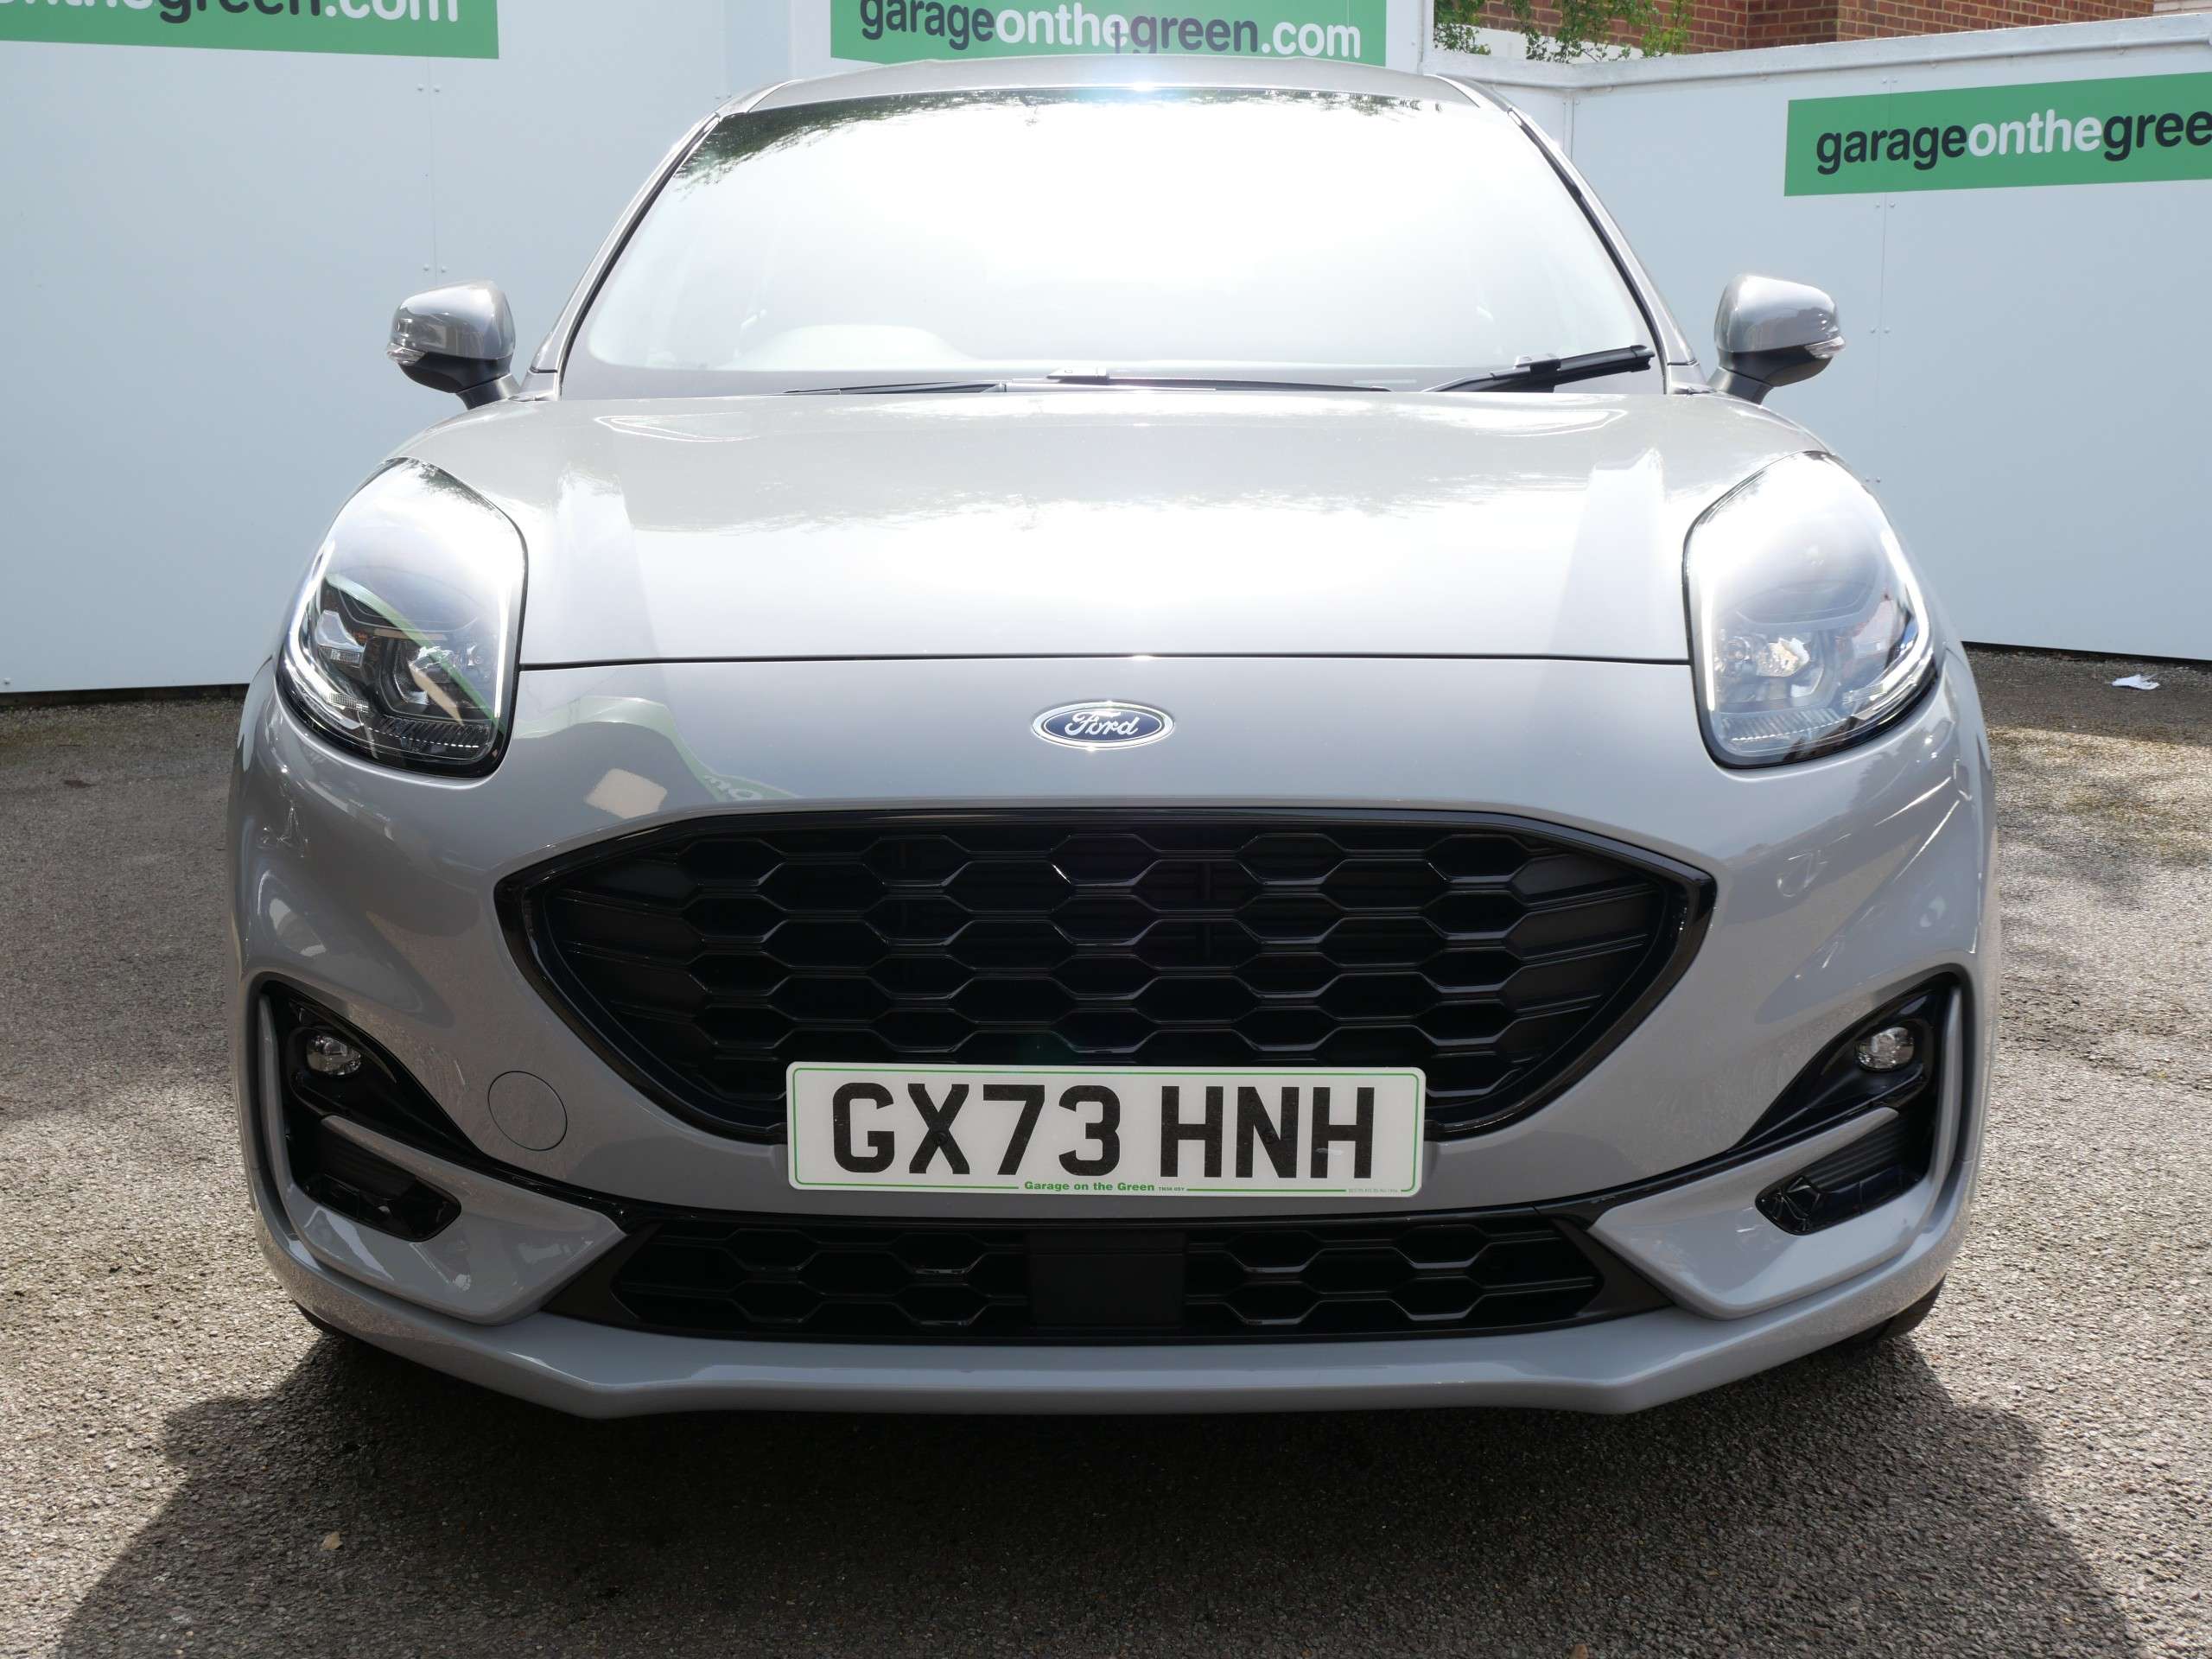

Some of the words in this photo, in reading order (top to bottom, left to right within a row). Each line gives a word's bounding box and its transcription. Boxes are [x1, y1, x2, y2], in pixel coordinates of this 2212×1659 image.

[860, 0, 1361, 59] garageonthegreen.com
[1064, 710, 1141, 735] Ford
[832, 1082, 1121, 1177] GX73
[1160, 1085, 1376, 1179] HNH
[1024, 1180, 1070, 1192] Garage
[1093, 1182, 1113, 1191] the
[1117, 1182, 1154, 1191] Green
